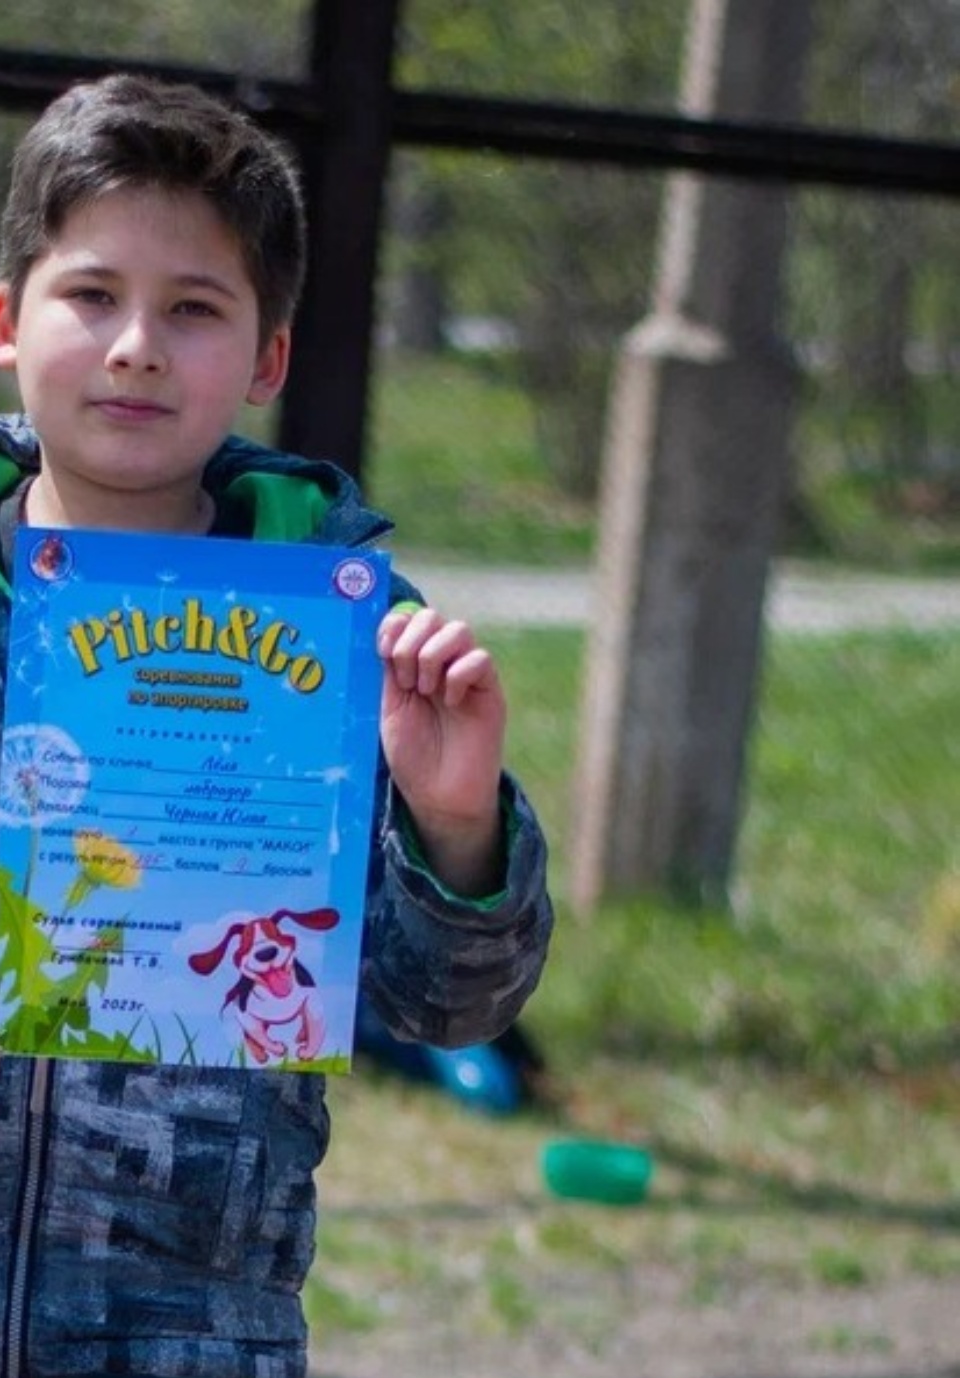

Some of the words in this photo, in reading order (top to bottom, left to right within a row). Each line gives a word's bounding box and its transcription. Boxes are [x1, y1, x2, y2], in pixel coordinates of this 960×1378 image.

[69, 598, 324, 694] Pitch&Go
[134, 667, 242, 688] соревнования
[127, 689, 148, 706] по
[150, 690, 250, 713] апортировке
[157, 833, 198, 847] место
